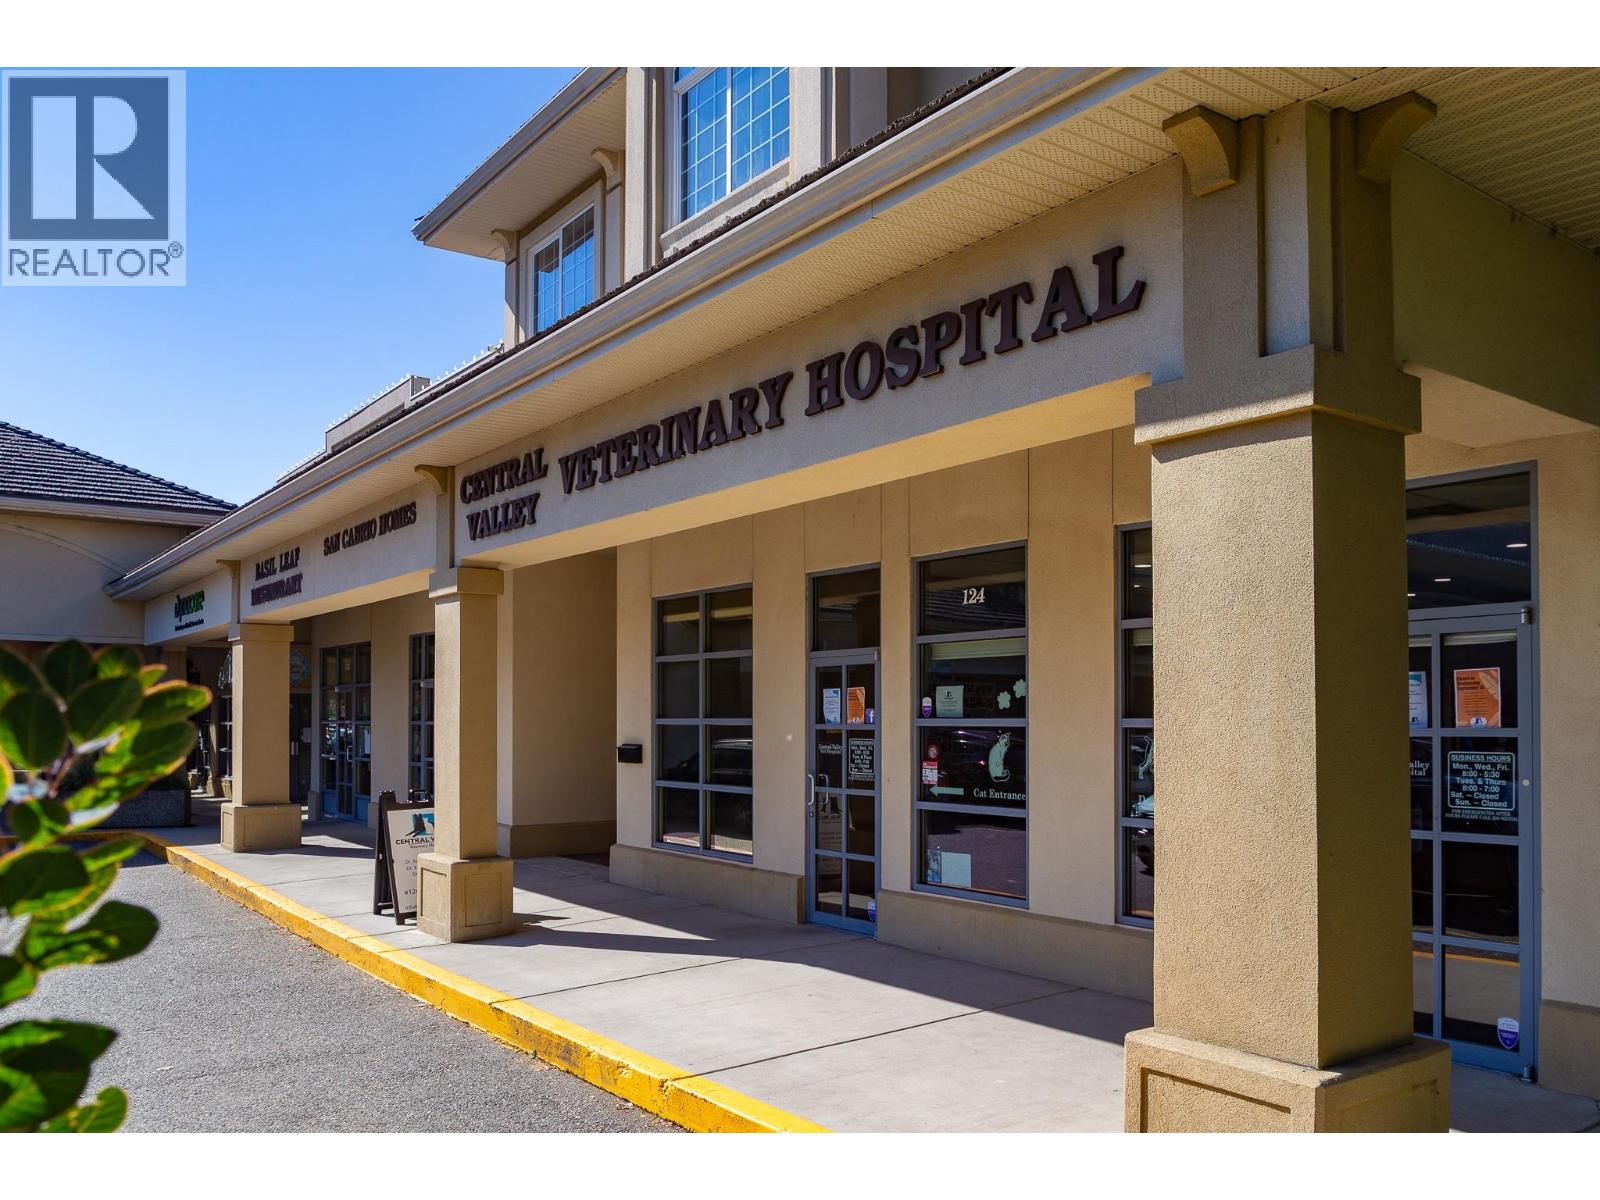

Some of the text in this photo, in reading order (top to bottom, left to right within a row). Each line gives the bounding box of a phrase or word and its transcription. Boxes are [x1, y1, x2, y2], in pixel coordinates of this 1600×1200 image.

[558, 245, 1147, 494] VETERINARY HOSPITAL
[460, 447, 549, 504] CENTRAL
[323, 530, 342, 556] SAN
[378, 501, 417, 536] HOMES
[466, 492, 541, 541] VALLEY
[255, 546, 301, 581] BASIL LEAF
[962, 586, 986, 604] 124
[1409, 760, 1430, 769] alley
[974, 788, 1026, 800] Cat Entrance
